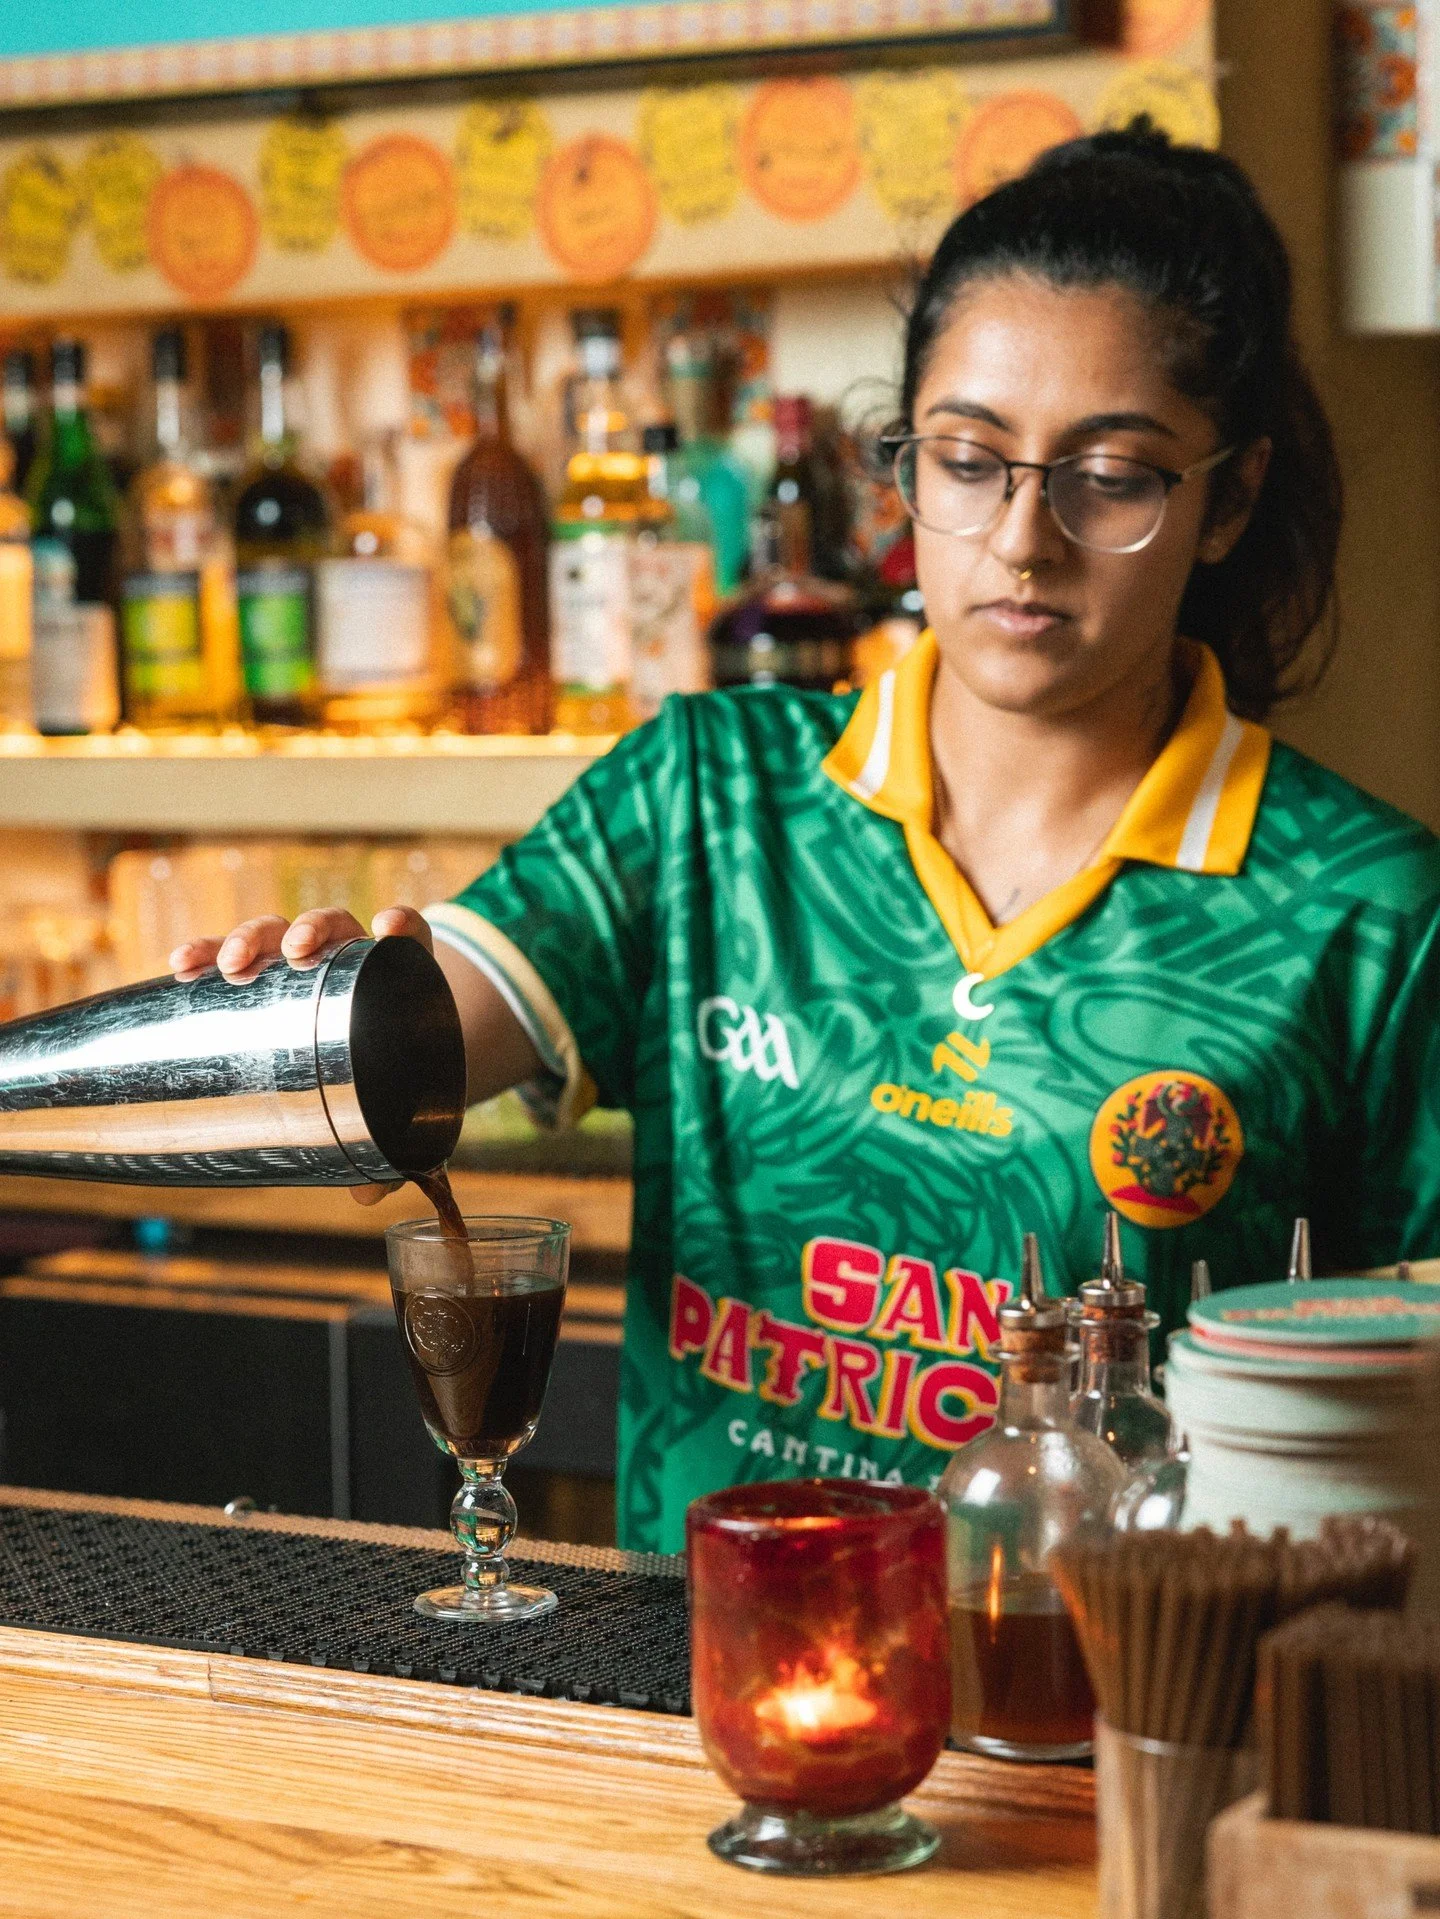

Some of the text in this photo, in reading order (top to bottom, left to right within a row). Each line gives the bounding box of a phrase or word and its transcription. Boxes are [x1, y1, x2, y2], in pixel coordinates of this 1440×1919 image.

[669, 1273, 1002, 1451] PATRIC
[801, 1236, 1013, 1362] SAN
[728, 1419, 903, 1488] CANTINA
